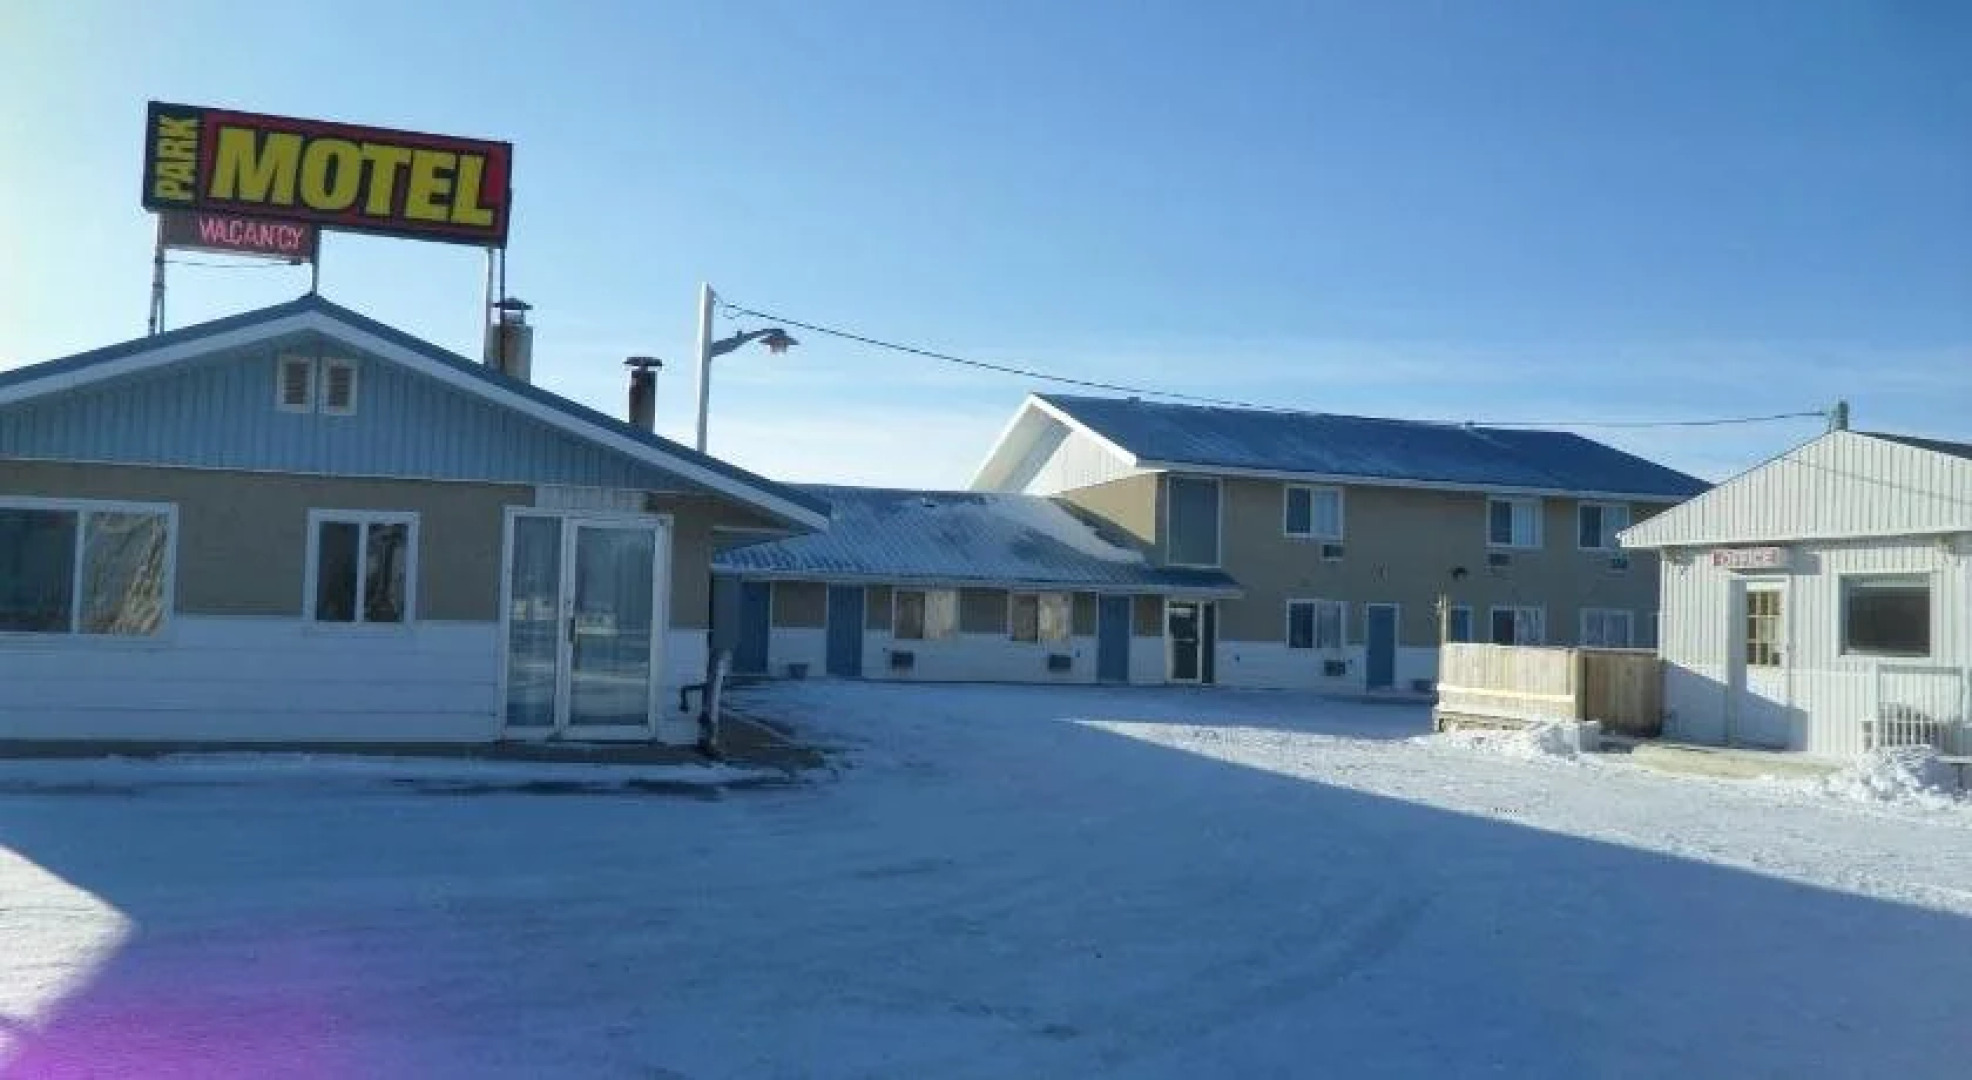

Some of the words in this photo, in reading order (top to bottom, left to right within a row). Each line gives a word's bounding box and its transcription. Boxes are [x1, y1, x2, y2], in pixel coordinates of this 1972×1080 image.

[155, 115, 198, 200] PARK
[209, 127, 493, 225] MOTEL
[200, 217, 303, 249] VACANCY
